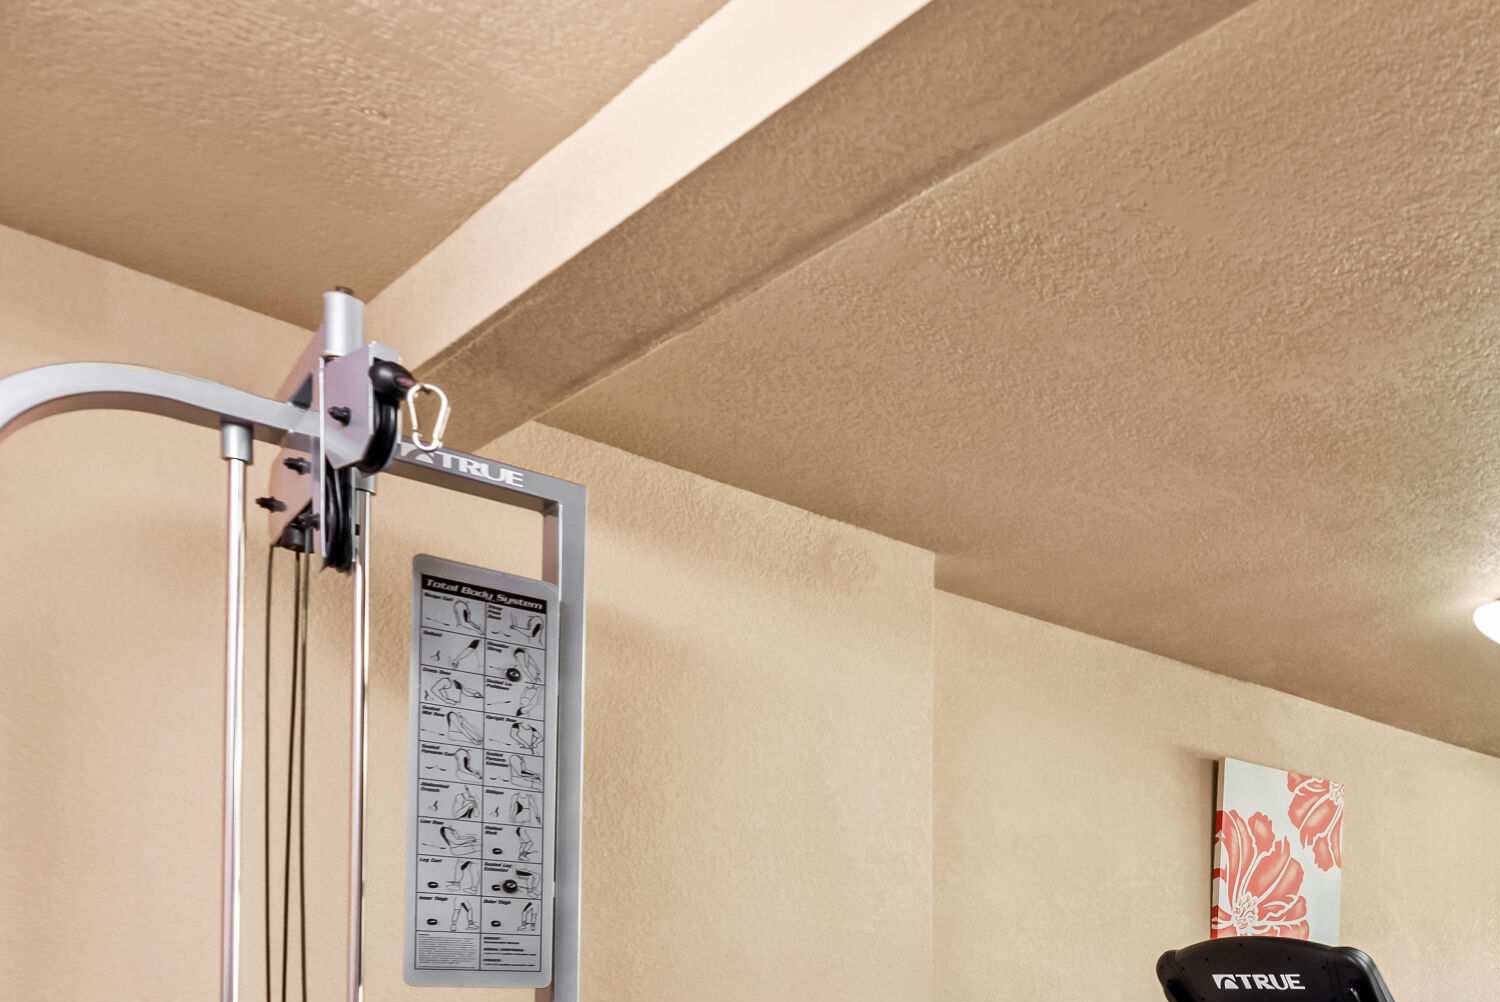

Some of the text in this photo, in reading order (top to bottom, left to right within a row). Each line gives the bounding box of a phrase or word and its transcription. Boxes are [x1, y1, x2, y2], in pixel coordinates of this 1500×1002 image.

[435, 451, 524, 487] TRUE
[426, 579, 543, 610] Total Body System
[1235, 974, 1306, 991] TRUE
